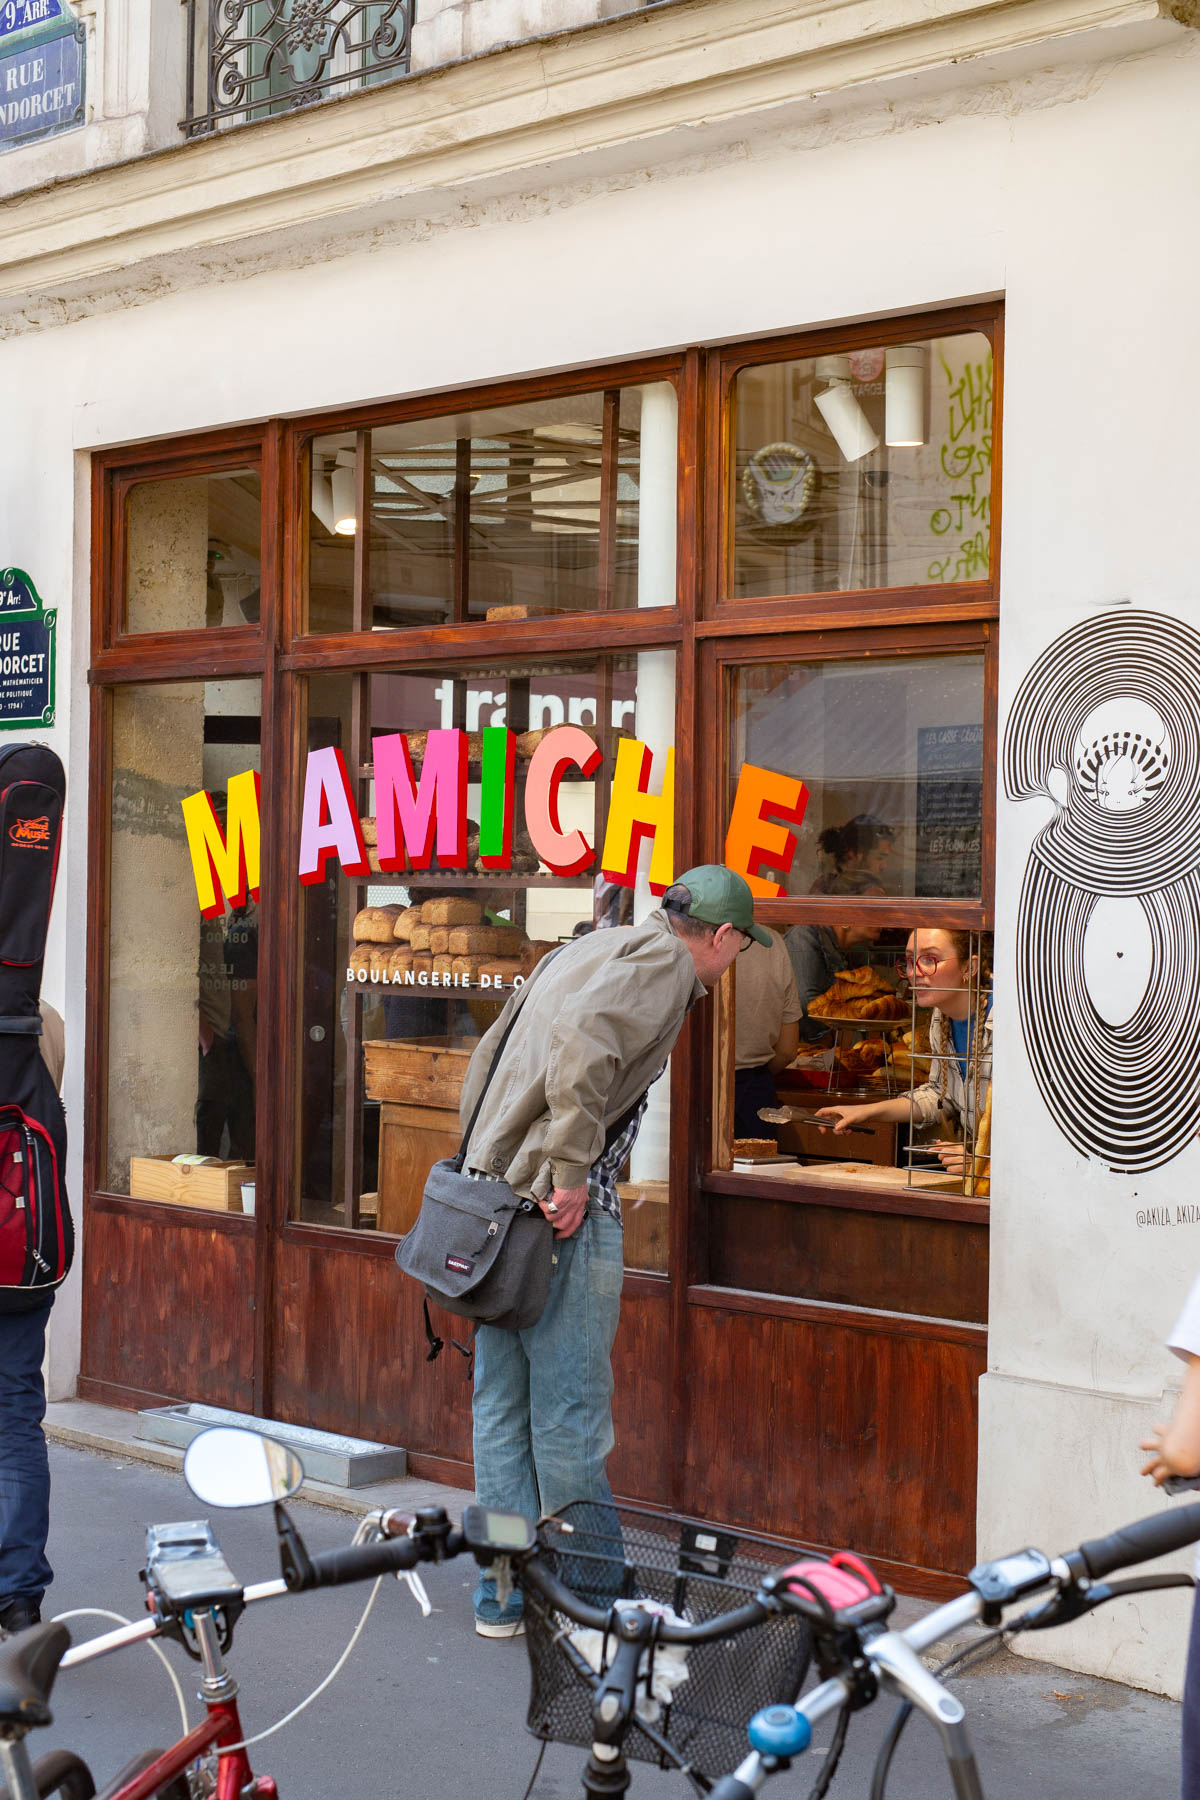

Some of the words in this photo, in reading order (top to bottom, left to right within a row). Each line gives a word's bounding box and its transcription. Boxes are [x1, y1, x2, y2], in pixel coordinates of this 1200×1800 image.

[6, 58, 44, 92] RUE
[0, 632, 20, 652] UE
[6, 689, 33, 698] POLITIQUE
[181, 726, 810, 920] MAMICHE
[346, 968, 470, 988] BOULANGERIE
[480, 974, 503, 989] DE
